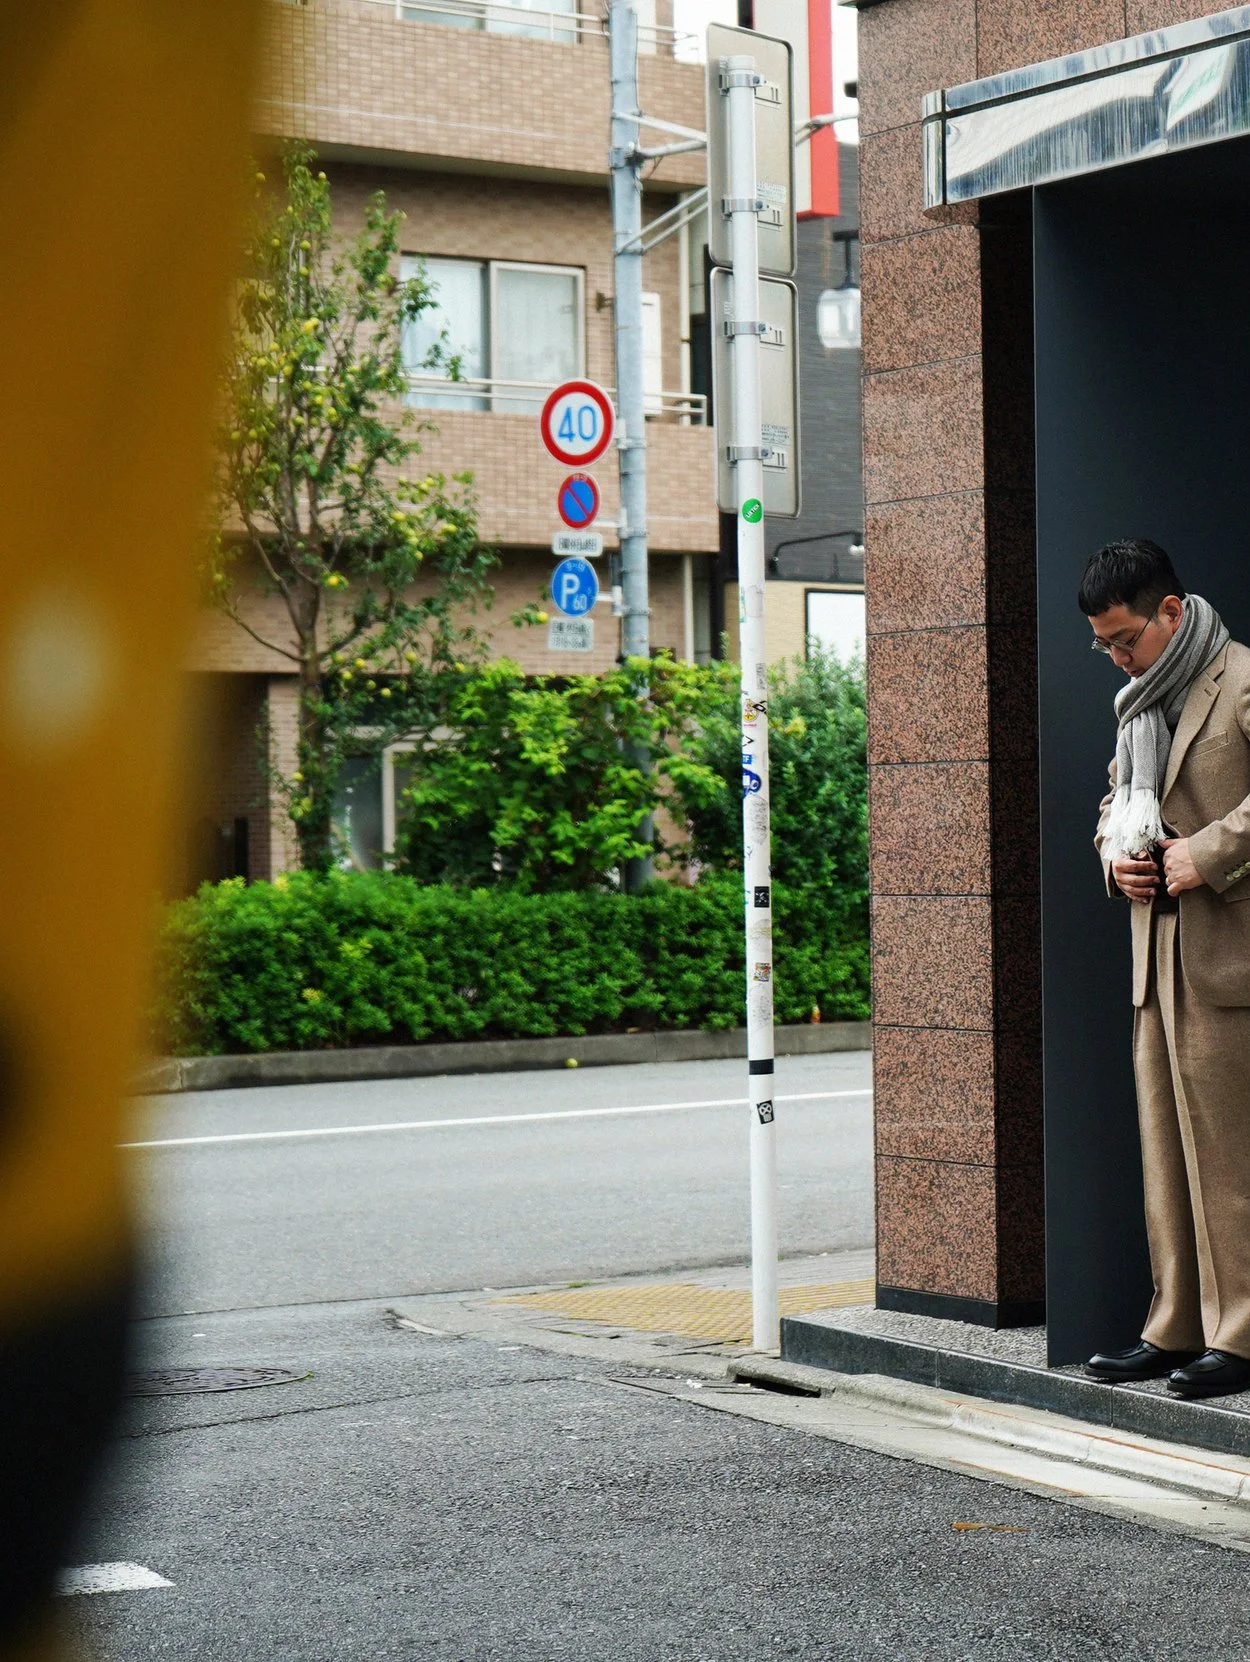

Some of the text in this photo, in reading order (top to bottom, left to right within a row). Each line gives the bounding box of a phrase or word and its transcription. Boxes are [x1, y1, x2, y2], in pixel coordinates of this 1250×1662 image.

[558, 405, 597, 442] 40
[561, 573, 580, 610] P
[573, 593, 588, 611] 60
